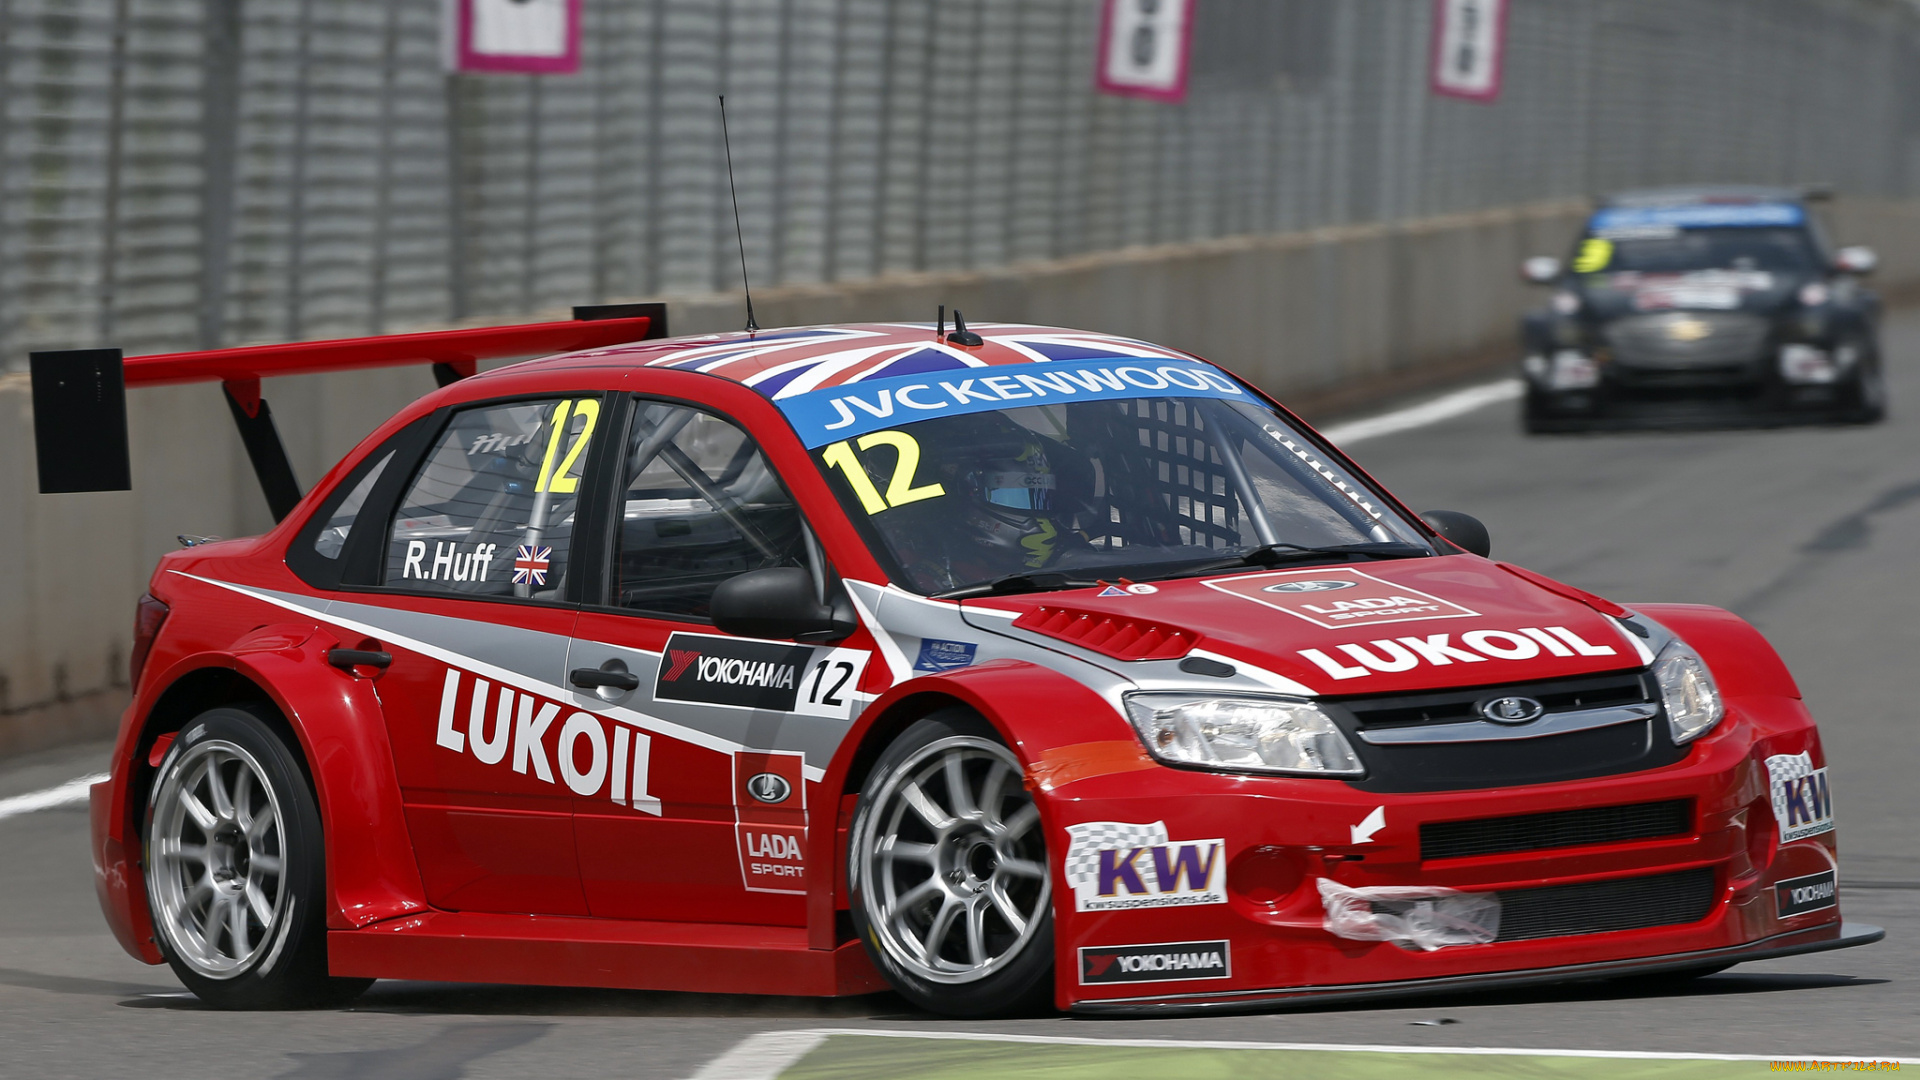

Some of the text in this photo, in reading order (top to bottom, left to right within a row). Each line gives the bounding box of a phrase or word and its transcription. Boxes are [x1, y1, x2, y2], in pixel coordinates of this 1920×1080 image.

[534, 398, 600, 493] 12
[822, 430, 946, 516] 12
[402, 540, 497, 582] R.Huff
[1300, 596, 1429, 614] LADA
[1328, 605, 1439, 620] SPORT
[697, 655, 794, 690] YOKOHAMA
[1297, 627, 1617, 680] LUKOIL
[808, 659, 855, 707] 12
[436, 668, 662, 817] LUKOIL
[1784, 771, 1831, 828] KW
[746, 832, 803, 860] LADA
[751, 863, 805, 877] SPORT
[1098, 843, 1221, 897] KW
[1085, 892, 1220, 910] kwsuspensions.de
[1791, 881, 1834, 905] YOKOHAMA
[1117, 951, 1224, 972] YOKOHAMA
